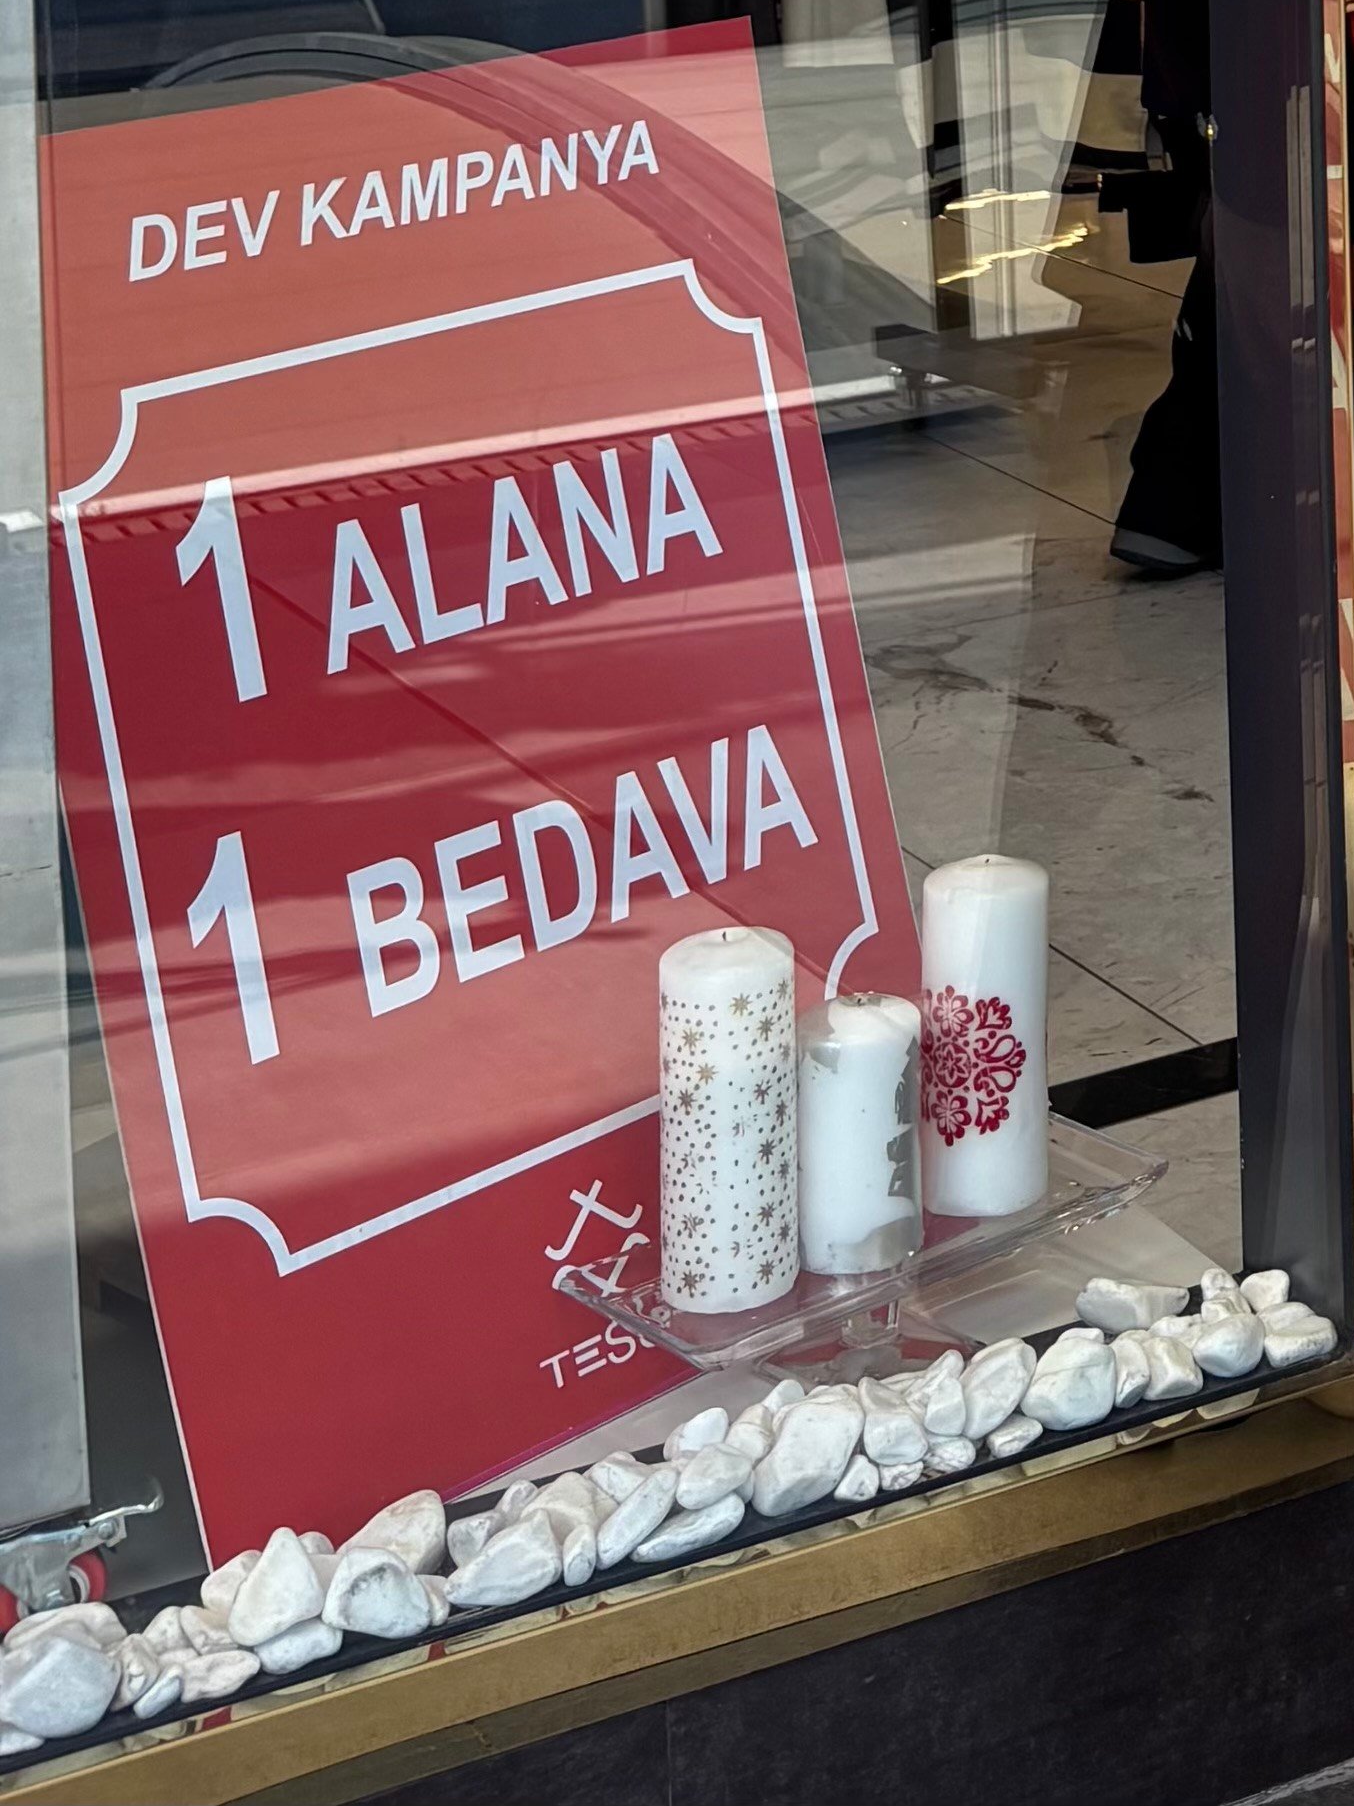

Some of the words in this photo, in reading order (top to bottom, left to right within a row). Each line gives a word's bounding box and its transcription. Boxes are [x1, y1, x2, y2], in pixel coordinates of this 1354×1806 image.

[128, 189, 281, 283] DEV
[300, 119, 660, 247] KAMPANYA
[177, 476, 268, 704] 1
[327, 433, 724, 675] ALANA
[186, 831, 281, 1066] 1
[346, 724, 819, 1019] BEDAVA
